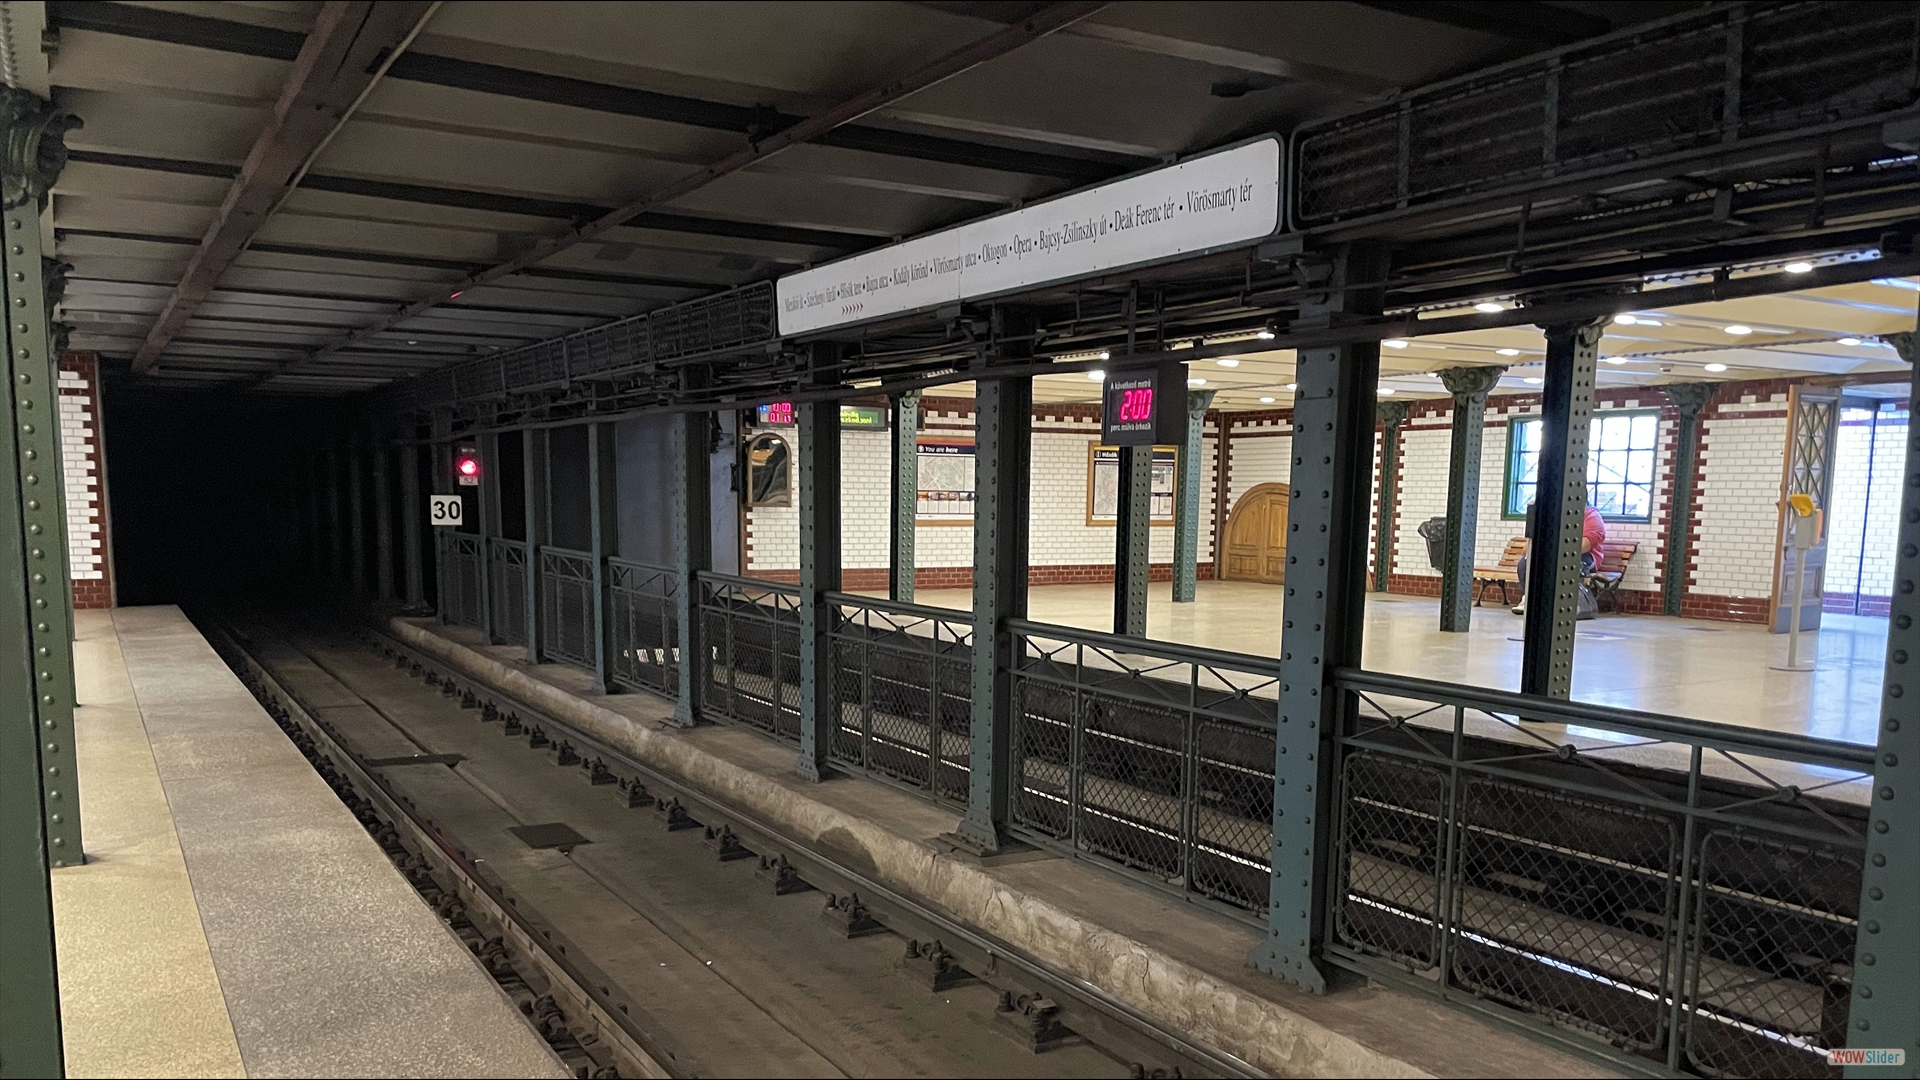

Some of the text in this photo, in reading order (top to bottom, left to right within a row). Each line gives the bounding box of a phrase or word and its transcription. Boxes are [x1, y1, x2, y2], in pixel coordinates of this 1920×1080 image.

[893, 265, 910, 287] Kodály
[911, 260, 928, 282] körönd
[933, 255, 964, 275] Vörösmarty
[965, 251, 977, 268] utca
[982, 243, 1008, 265] Oktogon
[1013, 234, 1032, 260] Opera
[1039, 218, 1098, 254] Bajcsy-Zsilinszky
[1099, 213, 1107, 236] út
[1114, 207, 1134, 232] Deák
[1136, 204, 1162, 227] Ferenc
[1163, 195, 1175, 221] tér
[1186, 184, 1238, 214] Vörösmarty
[1239, 177, 1253, 204] tér
[1120, 388, 1152, 420] 2:00
[945, 446, 959, 454] here
[433, 501, 461, 520] 30
